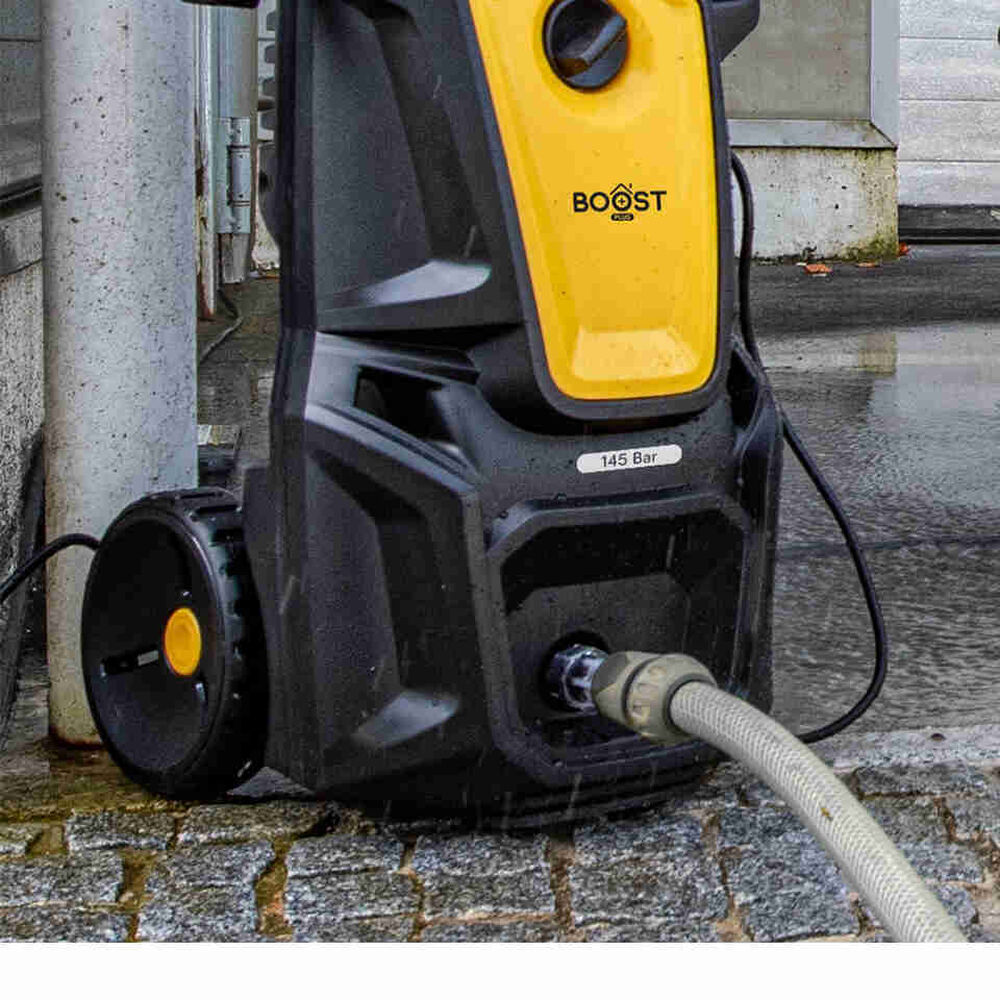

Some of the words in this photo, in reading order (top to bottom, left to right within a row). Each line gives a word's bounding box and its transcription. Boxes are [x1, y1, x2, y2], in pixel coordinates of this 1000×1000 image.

[573, 189, 667, 212] BOOST
[601, 453, 627, 467] 145
[633, 451, 657, 464] Bar
